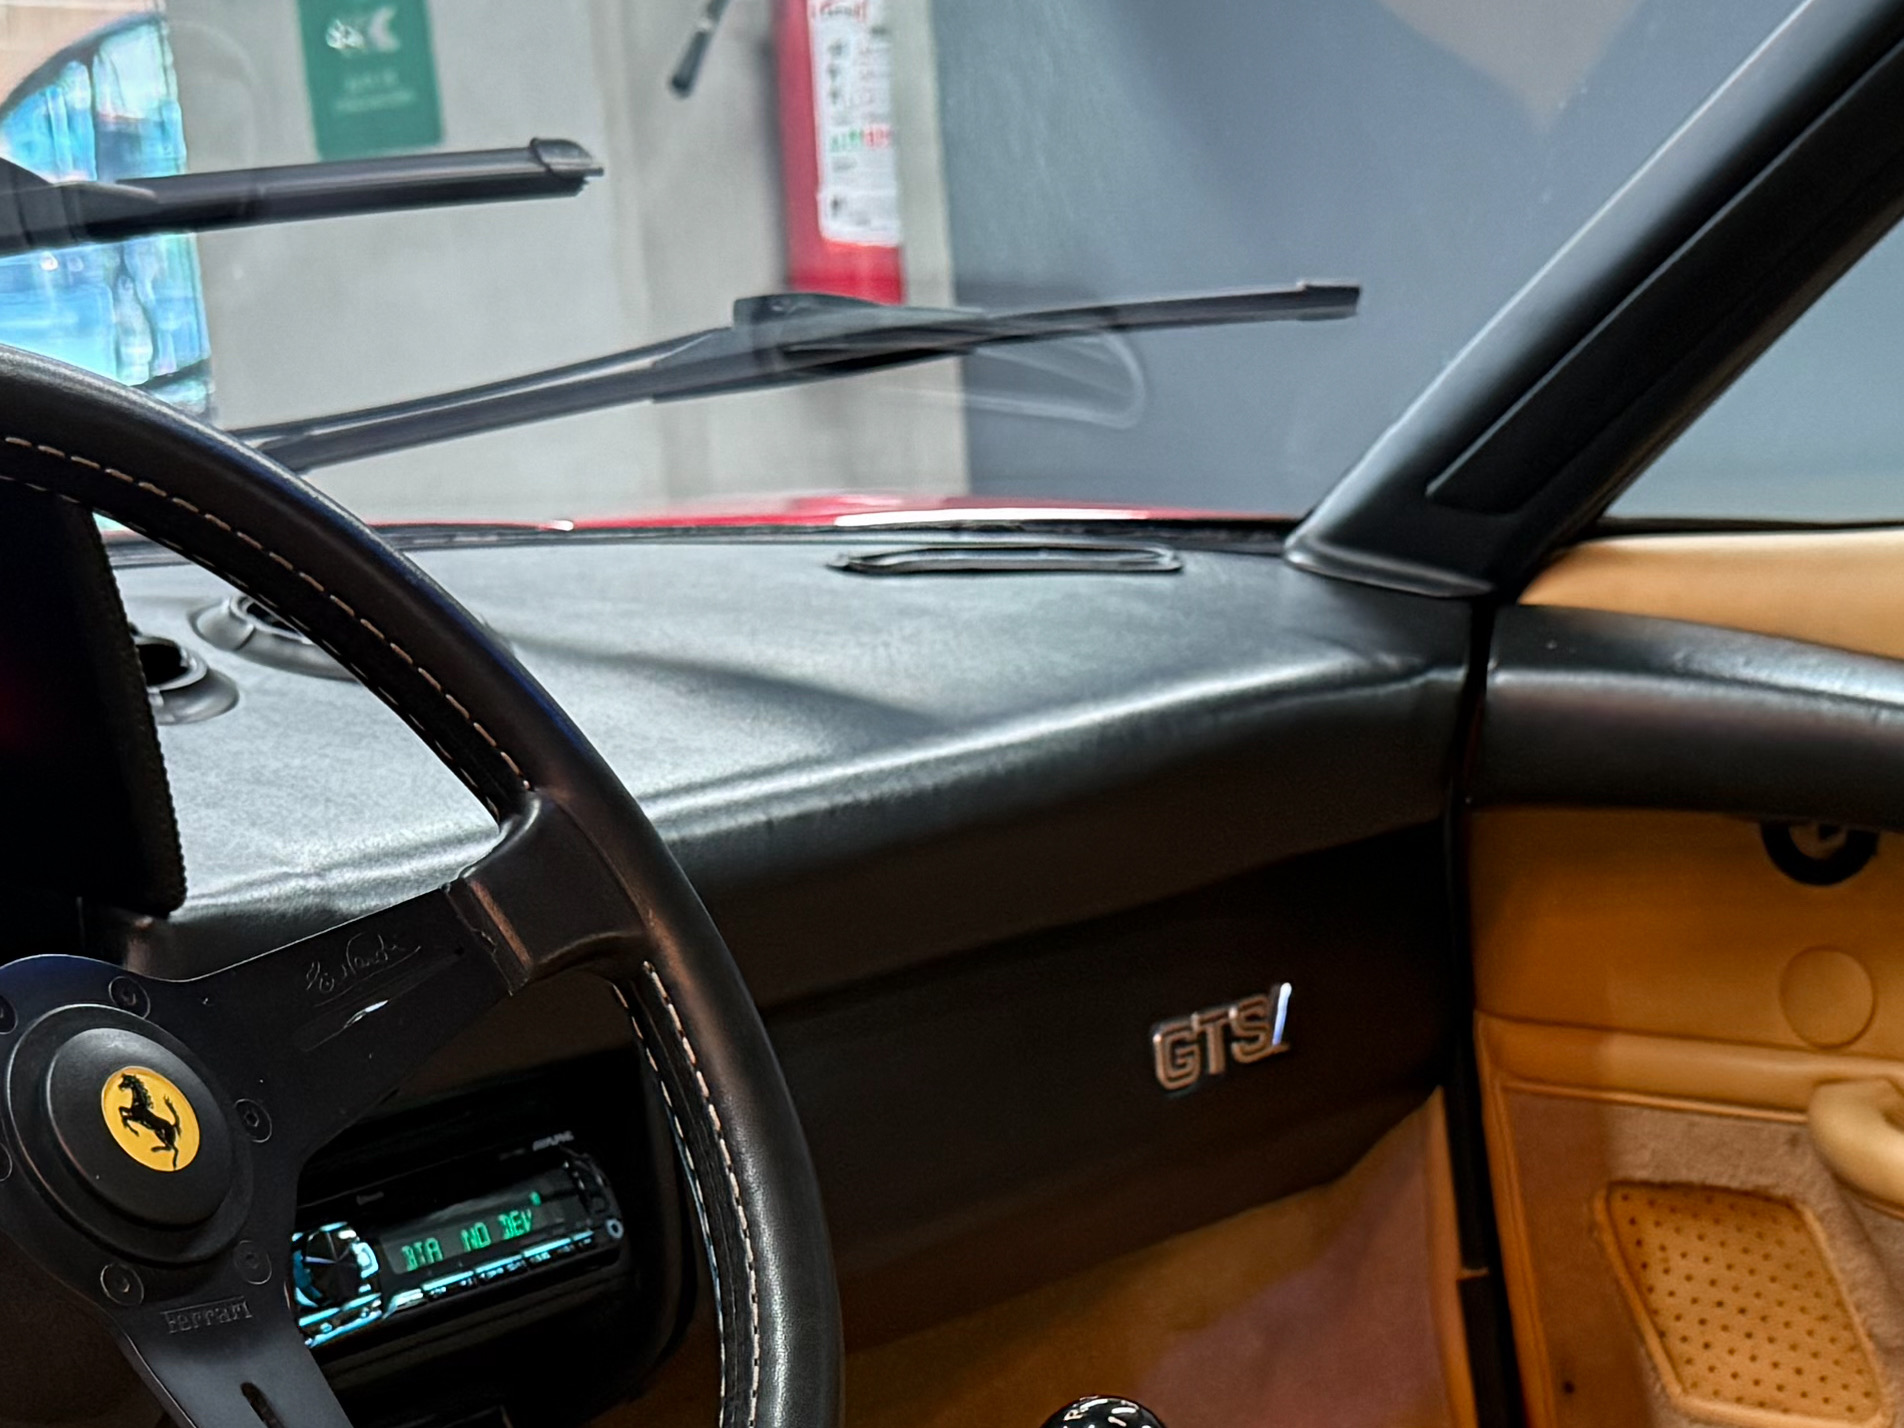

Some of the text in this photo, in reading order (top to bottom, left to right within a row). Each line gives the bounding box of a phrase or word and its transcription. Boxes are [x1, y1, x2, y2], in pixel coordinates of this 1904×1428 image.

[460, 1221, 493, 1252] NO
[498, 1208, 534, 1241] DEV
[160, 1295, 254, 1335] Ferrari
